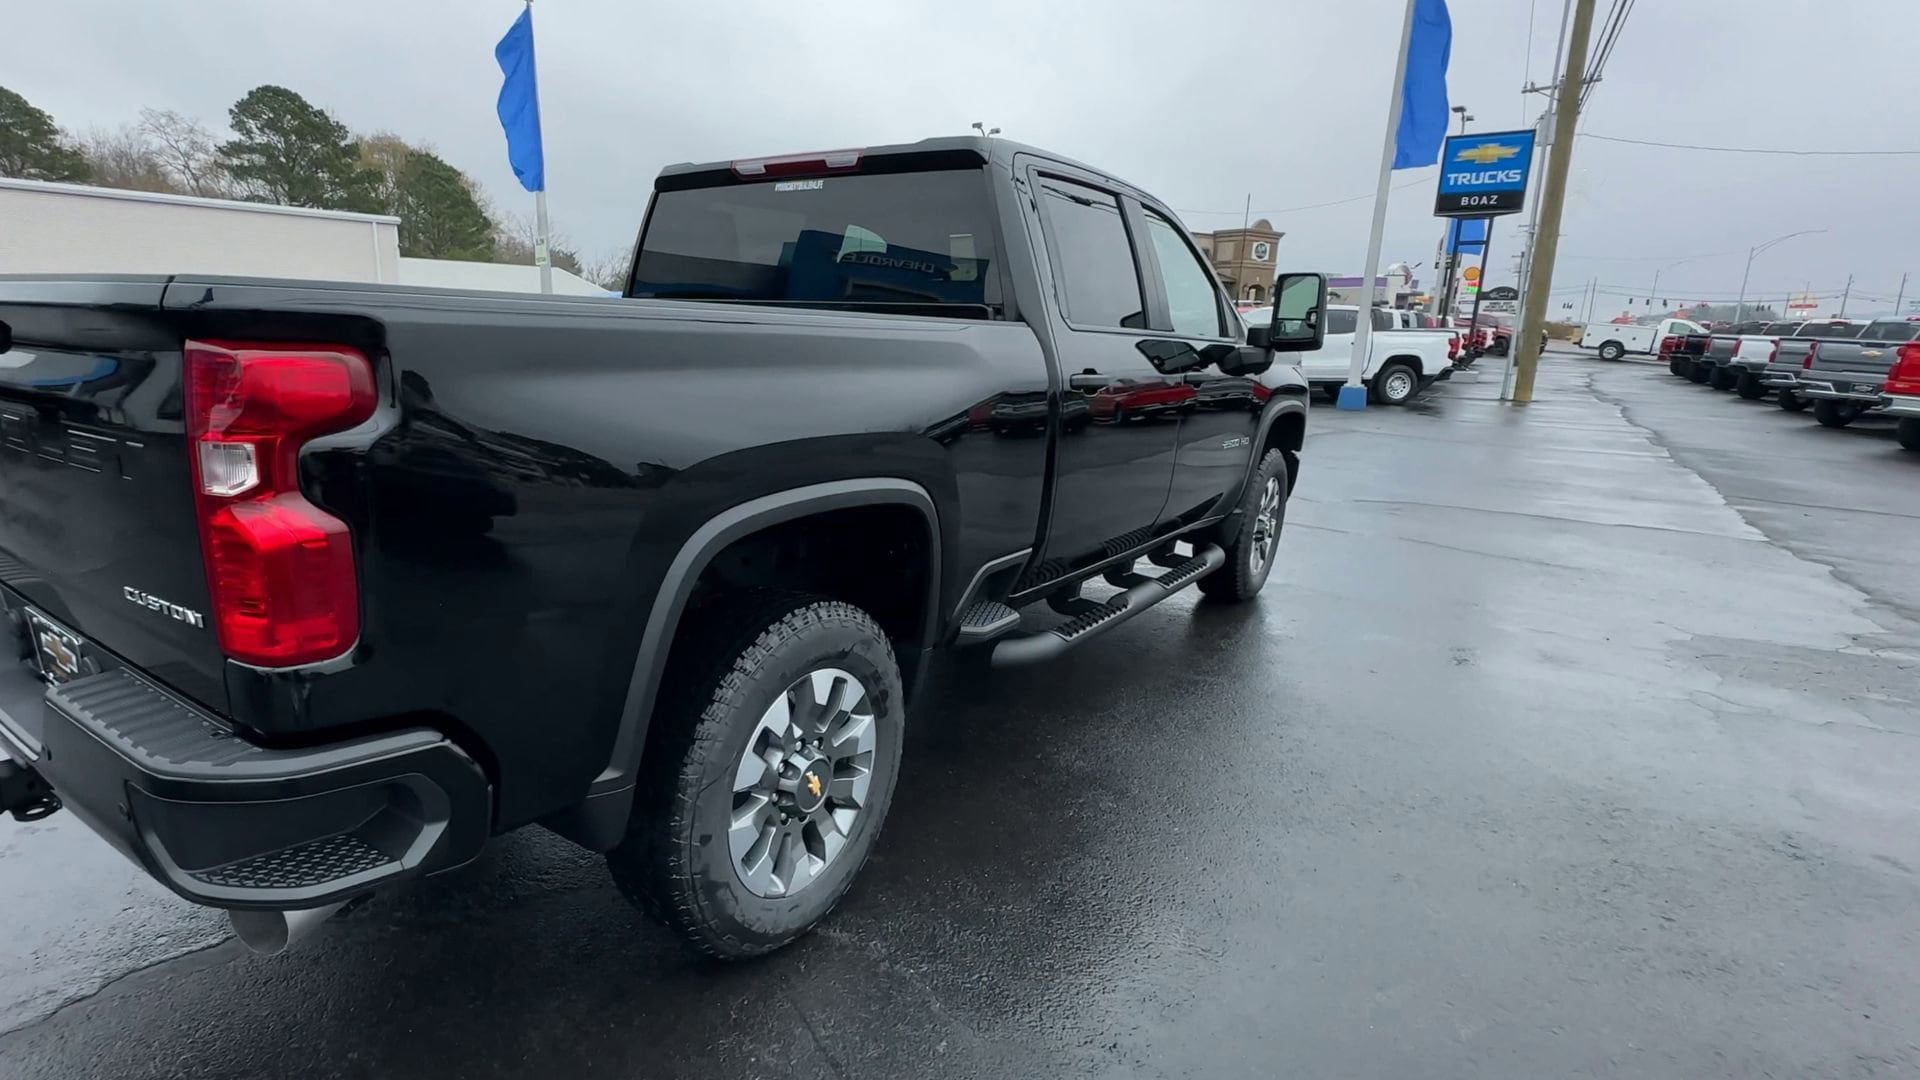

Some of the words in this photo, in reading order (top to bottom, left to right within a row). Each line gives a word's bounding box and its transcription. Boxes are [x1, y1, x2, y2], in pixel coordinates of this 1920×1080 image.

[1447, 170, 1521, 185] TRUCKS
[1460, 195, 1498, 205] BOAZ
[123, 585, 204, 629] CUSTOM
